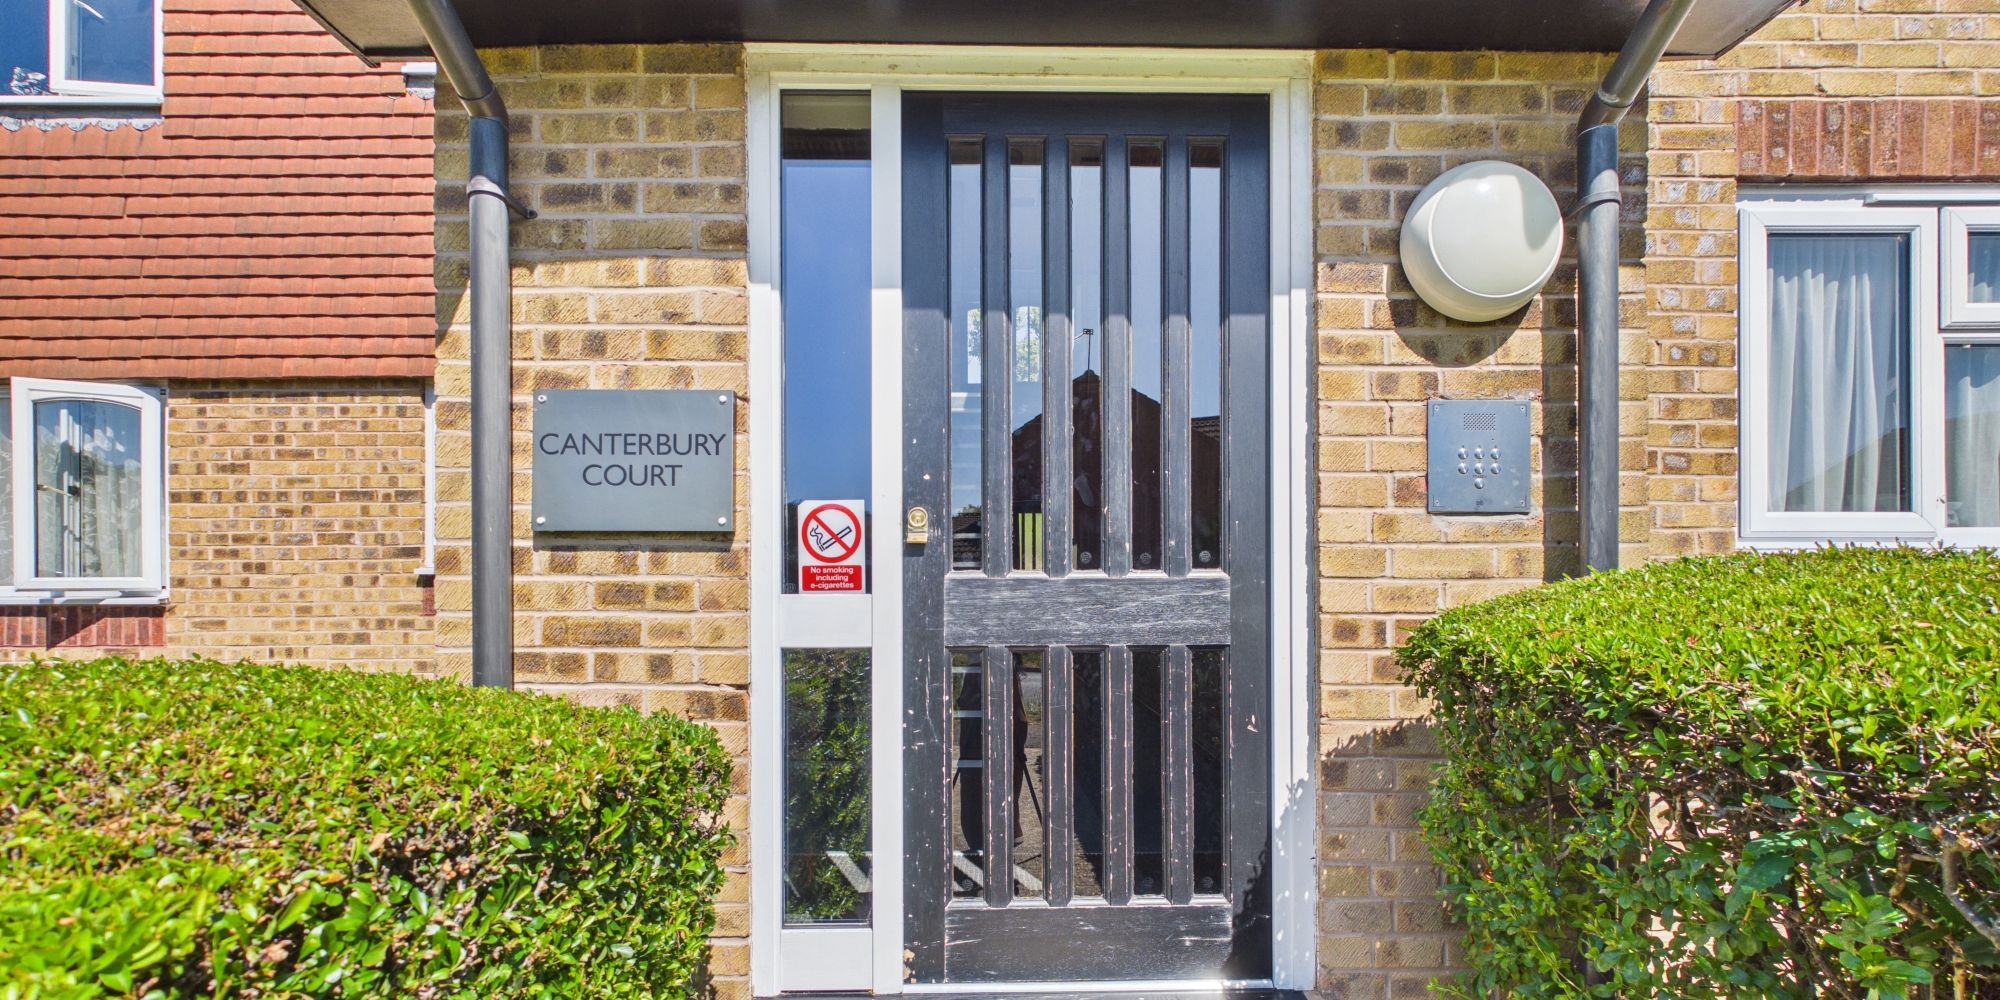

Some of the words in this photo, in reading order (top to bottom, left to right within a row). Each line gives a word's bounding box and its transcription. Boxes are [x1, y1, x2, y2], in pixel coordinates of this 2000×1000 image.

[539, 433, 726, 455] CANTERBURY
[582, 464, 683, 486] COURT
[815, 574, 848, 582] including
